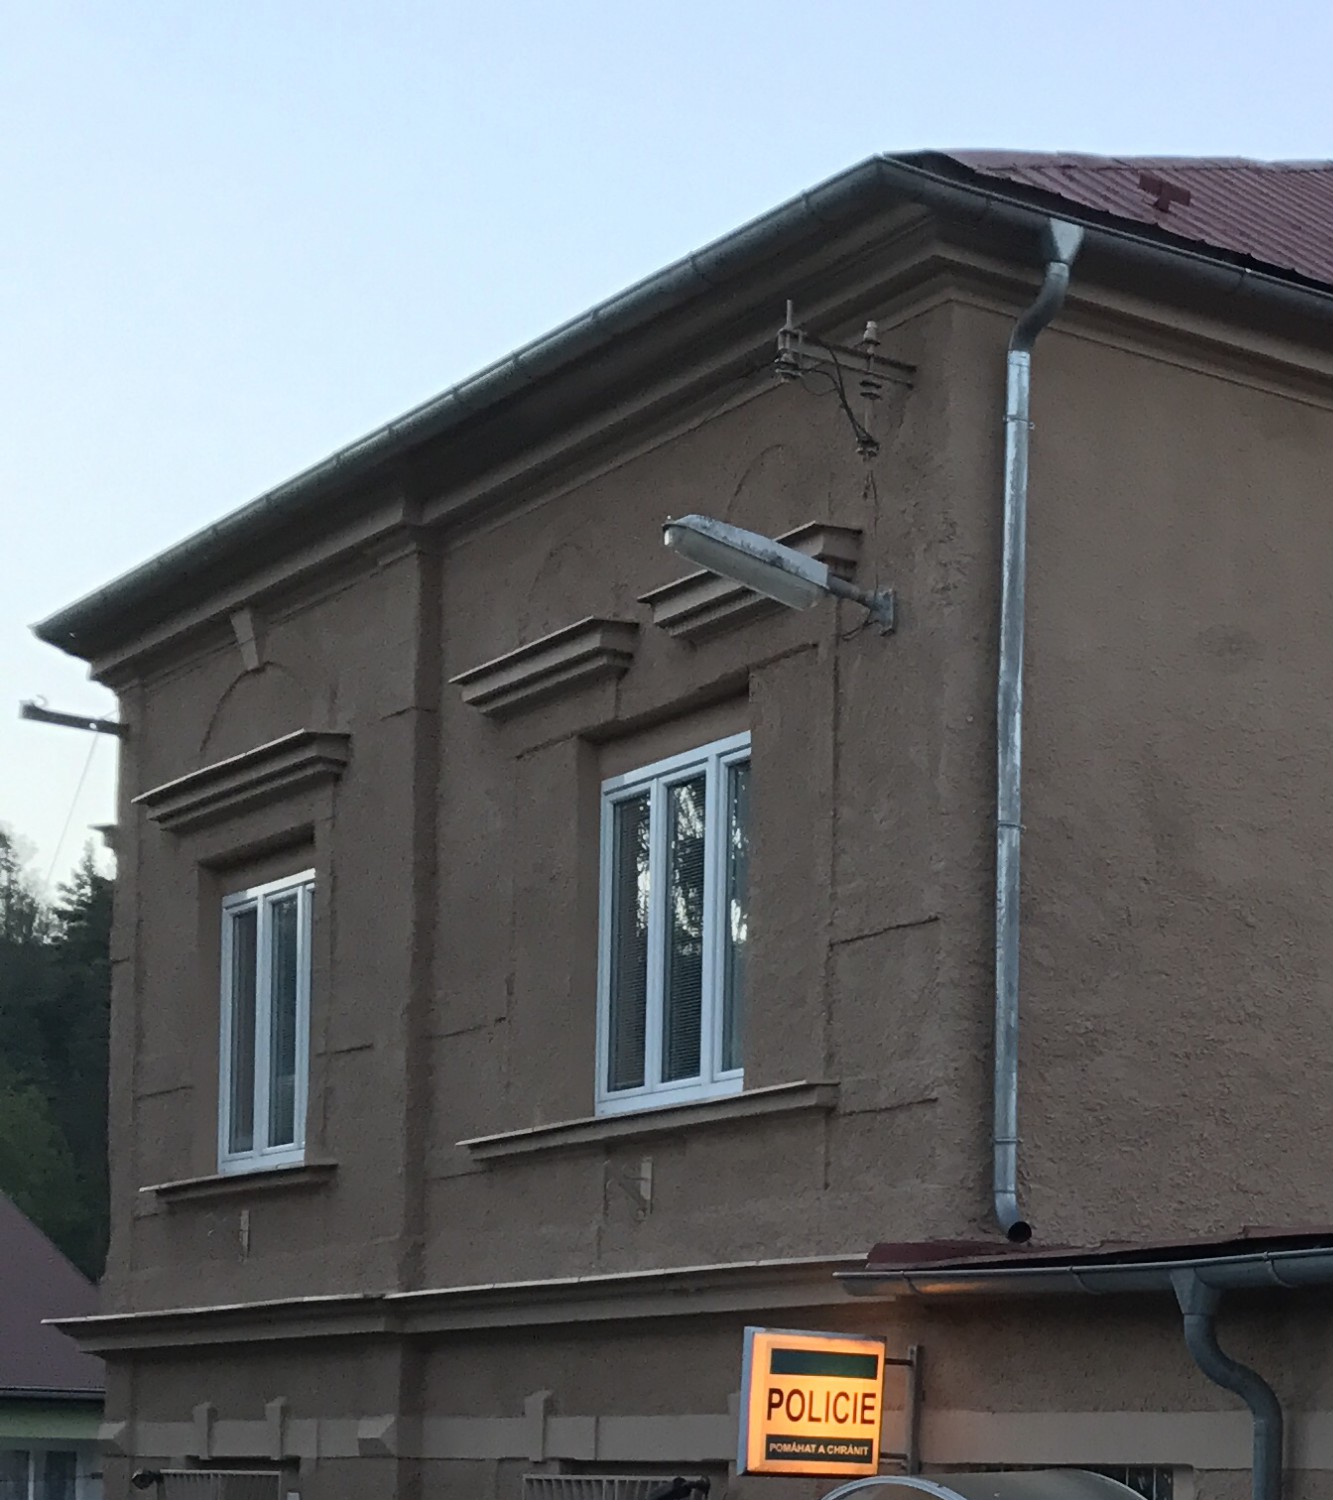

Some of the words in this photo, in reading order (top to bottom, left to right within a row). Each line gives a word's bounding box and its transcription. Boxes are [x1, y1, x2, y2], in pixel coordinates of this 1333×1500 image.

[766, 1387, 877, 1425] POLICIE
[769, 1441, 817, 1454] POMÁHAT
[817, 1444, 826, 1454] A
[826, 1444, 869, 1456] CHRÁNIT
